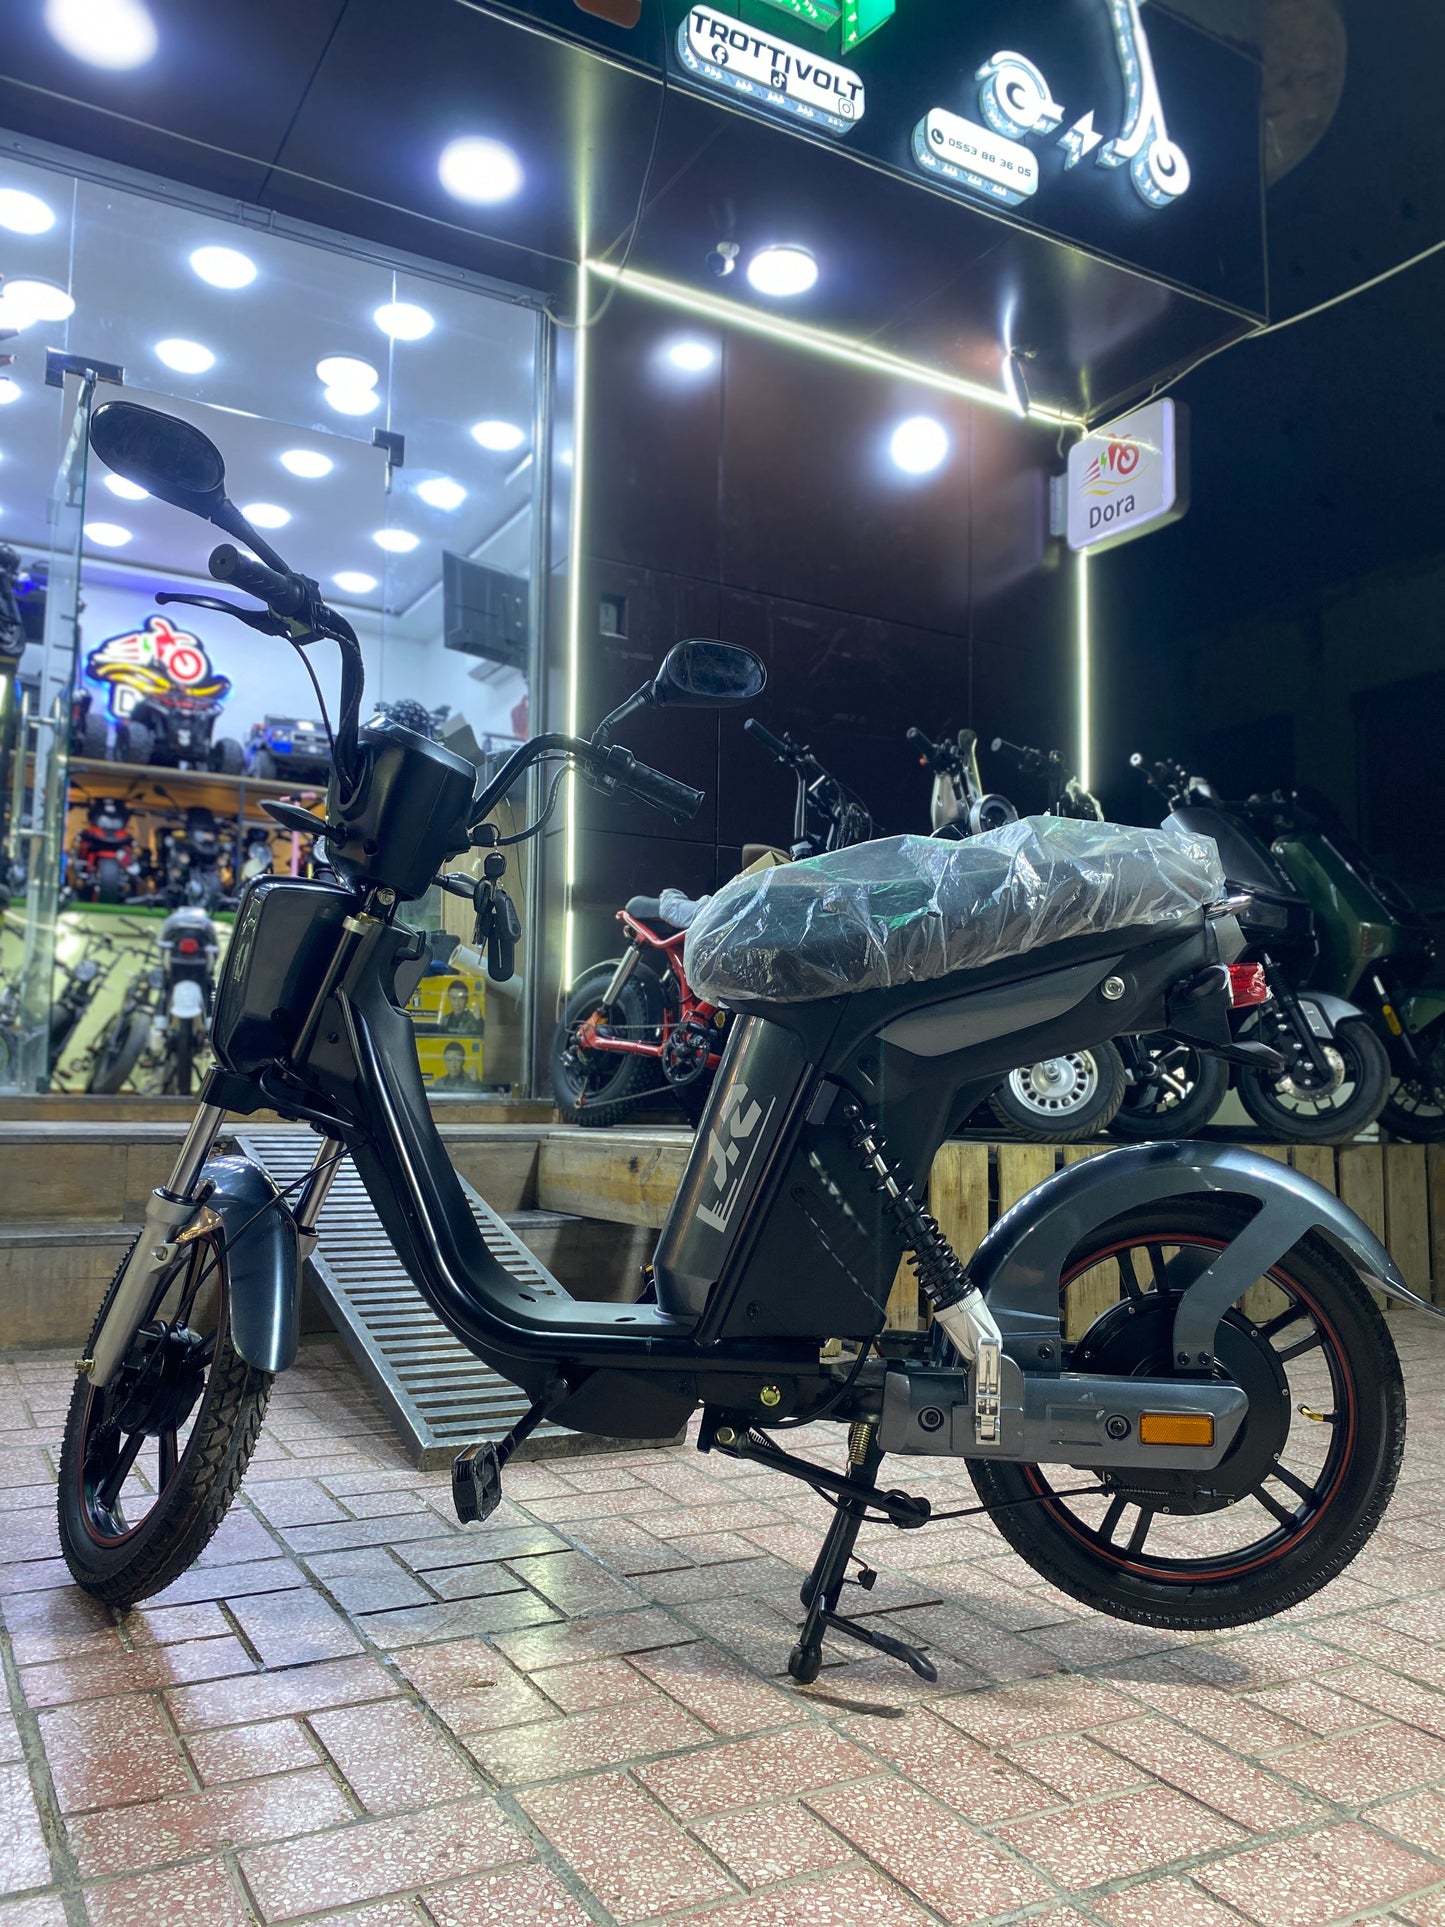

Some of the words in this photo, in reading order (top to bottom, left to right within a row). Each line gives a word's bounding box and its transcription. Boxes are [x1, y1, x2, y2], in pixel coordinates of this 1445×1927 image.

[691, 10, 863, 100] TROTTIVOLT
[948, 138, 977, 155] 0553
[981, 151, 995, 163] 88
[1000, 158, 1013, 170] 36
[1017, 165, 1031, 177] 05
[1090, 494, 1135, 528] Dora
